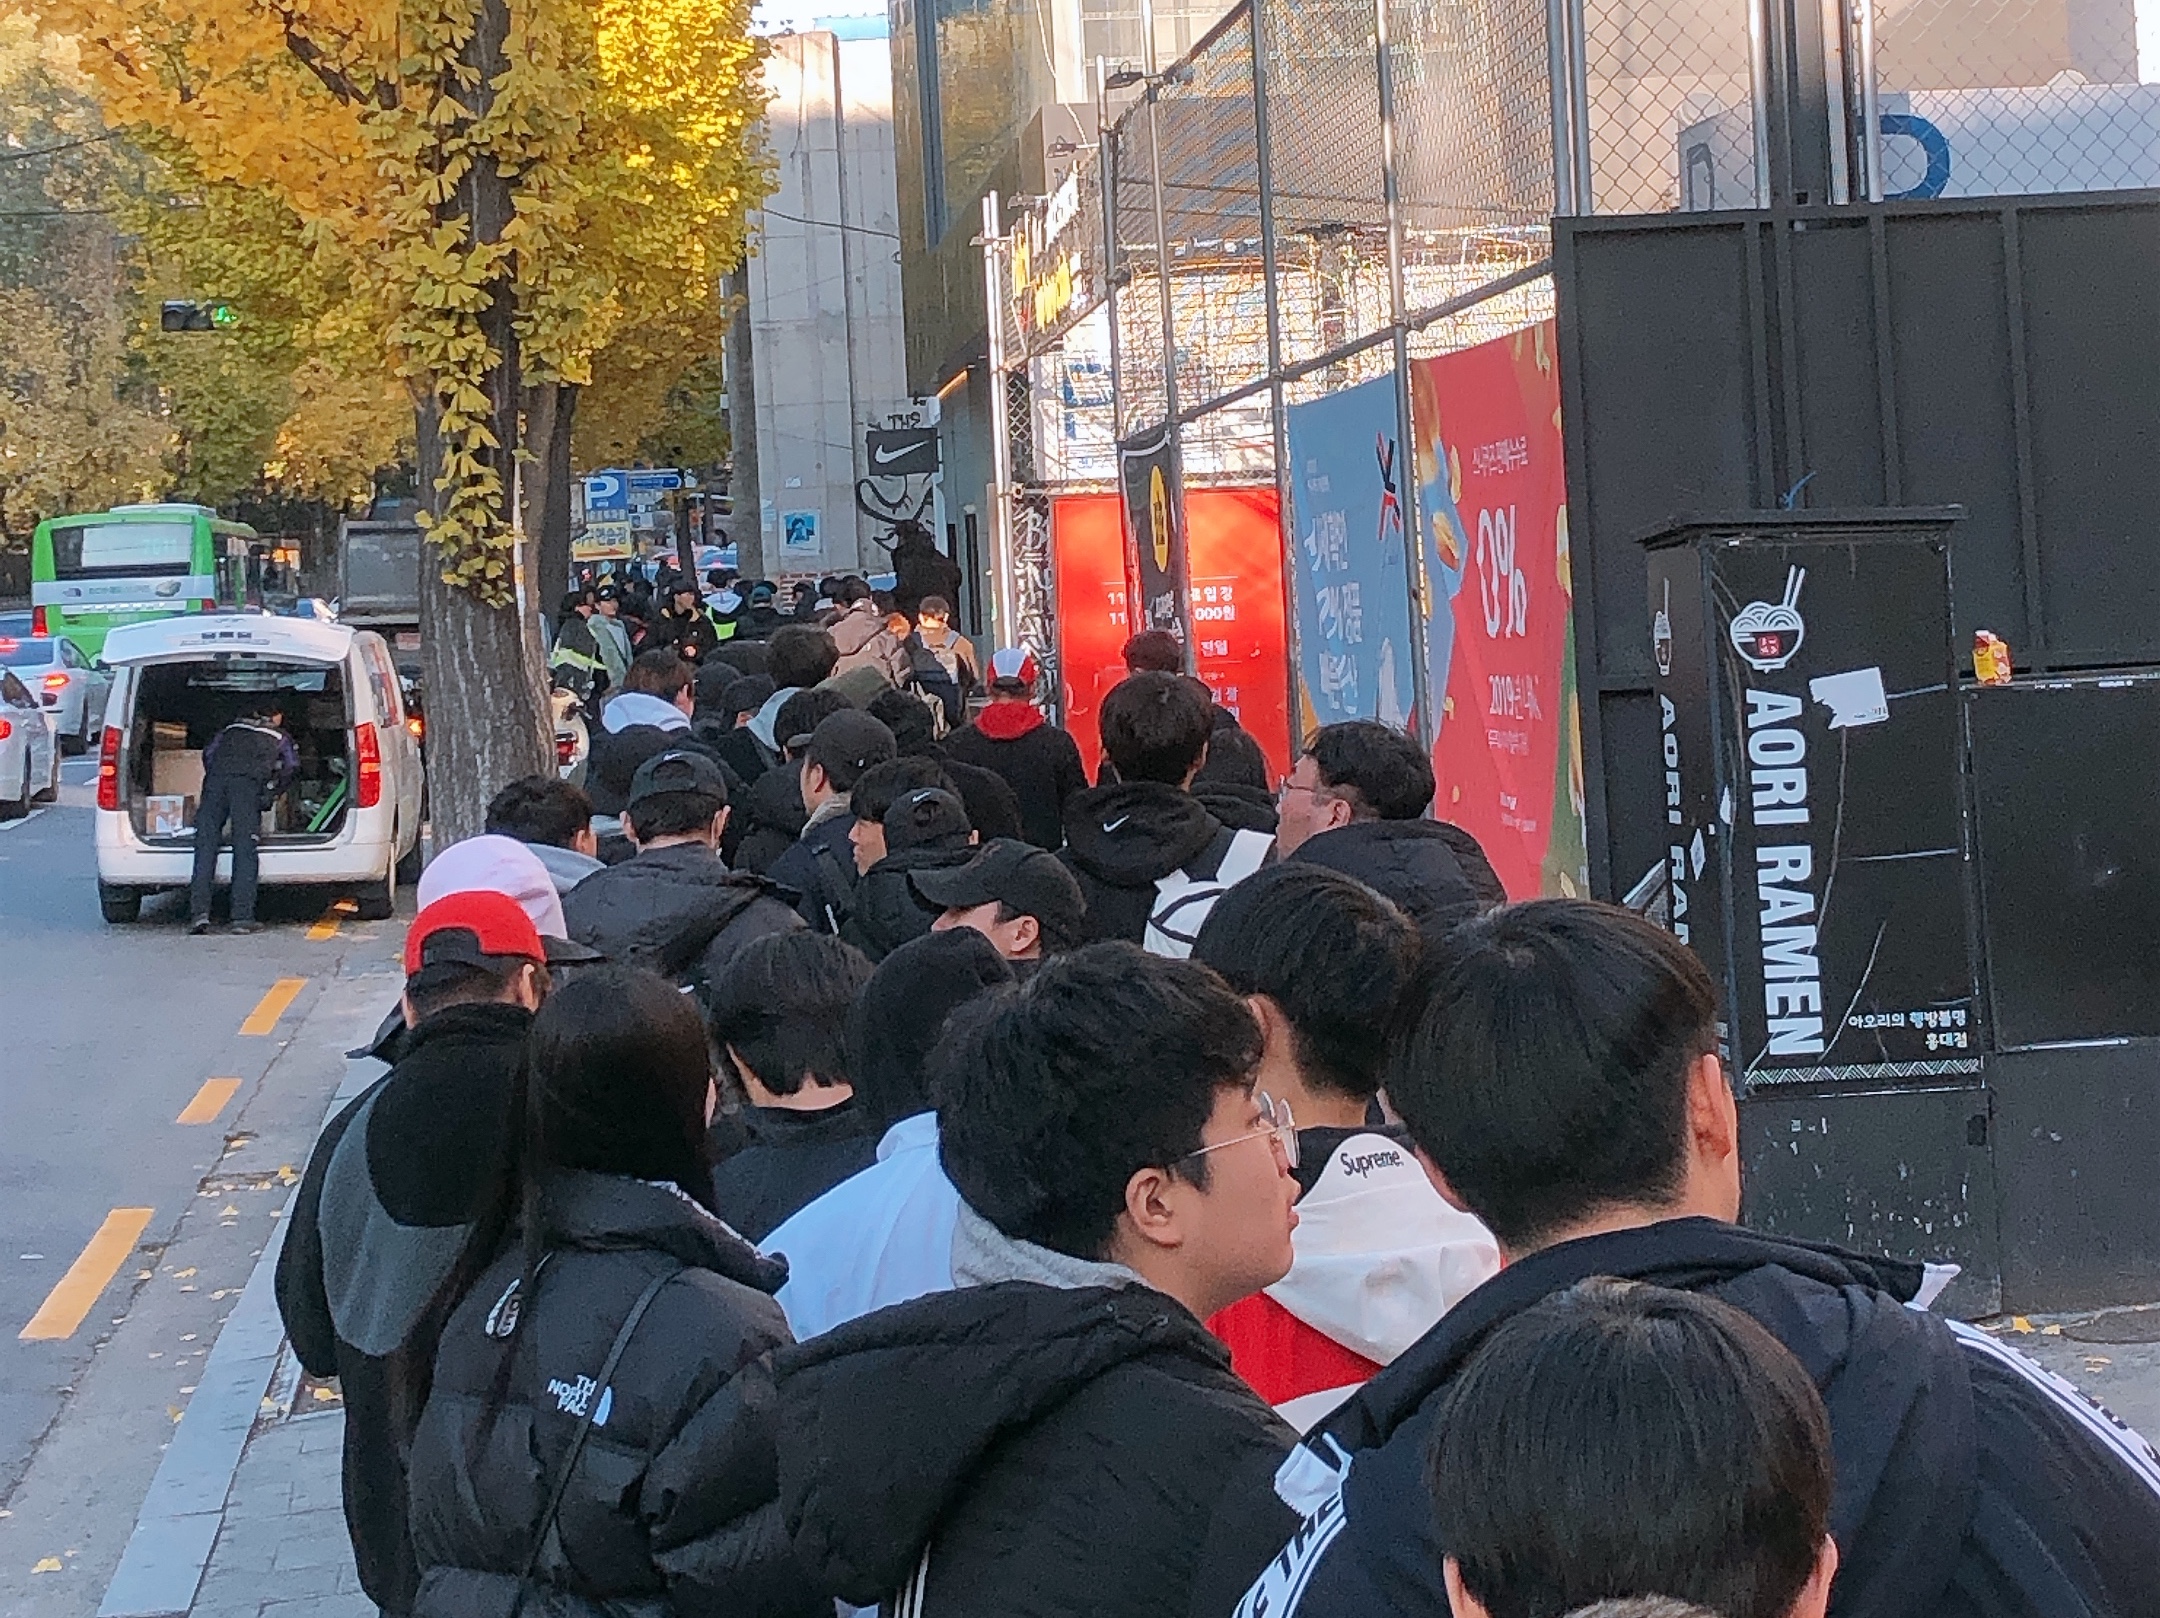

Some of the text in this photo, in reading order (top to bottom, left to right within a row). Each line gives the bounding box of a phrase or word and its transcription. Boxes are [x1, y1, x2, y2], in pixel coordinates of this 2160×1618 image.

[585, 475, 620, 511] P
[1476, 503, 1529, 640] 0%
[1660, 693, 1682, 825] AORI
[1746, 689, 1826, 1055] AORI RAMEN
[1848, 1012, 1905, 1029] 아오리의
[1925, 1031, 1968, 1051] 홍대점
[1340, 1149, 1402, 1179] Supreme
